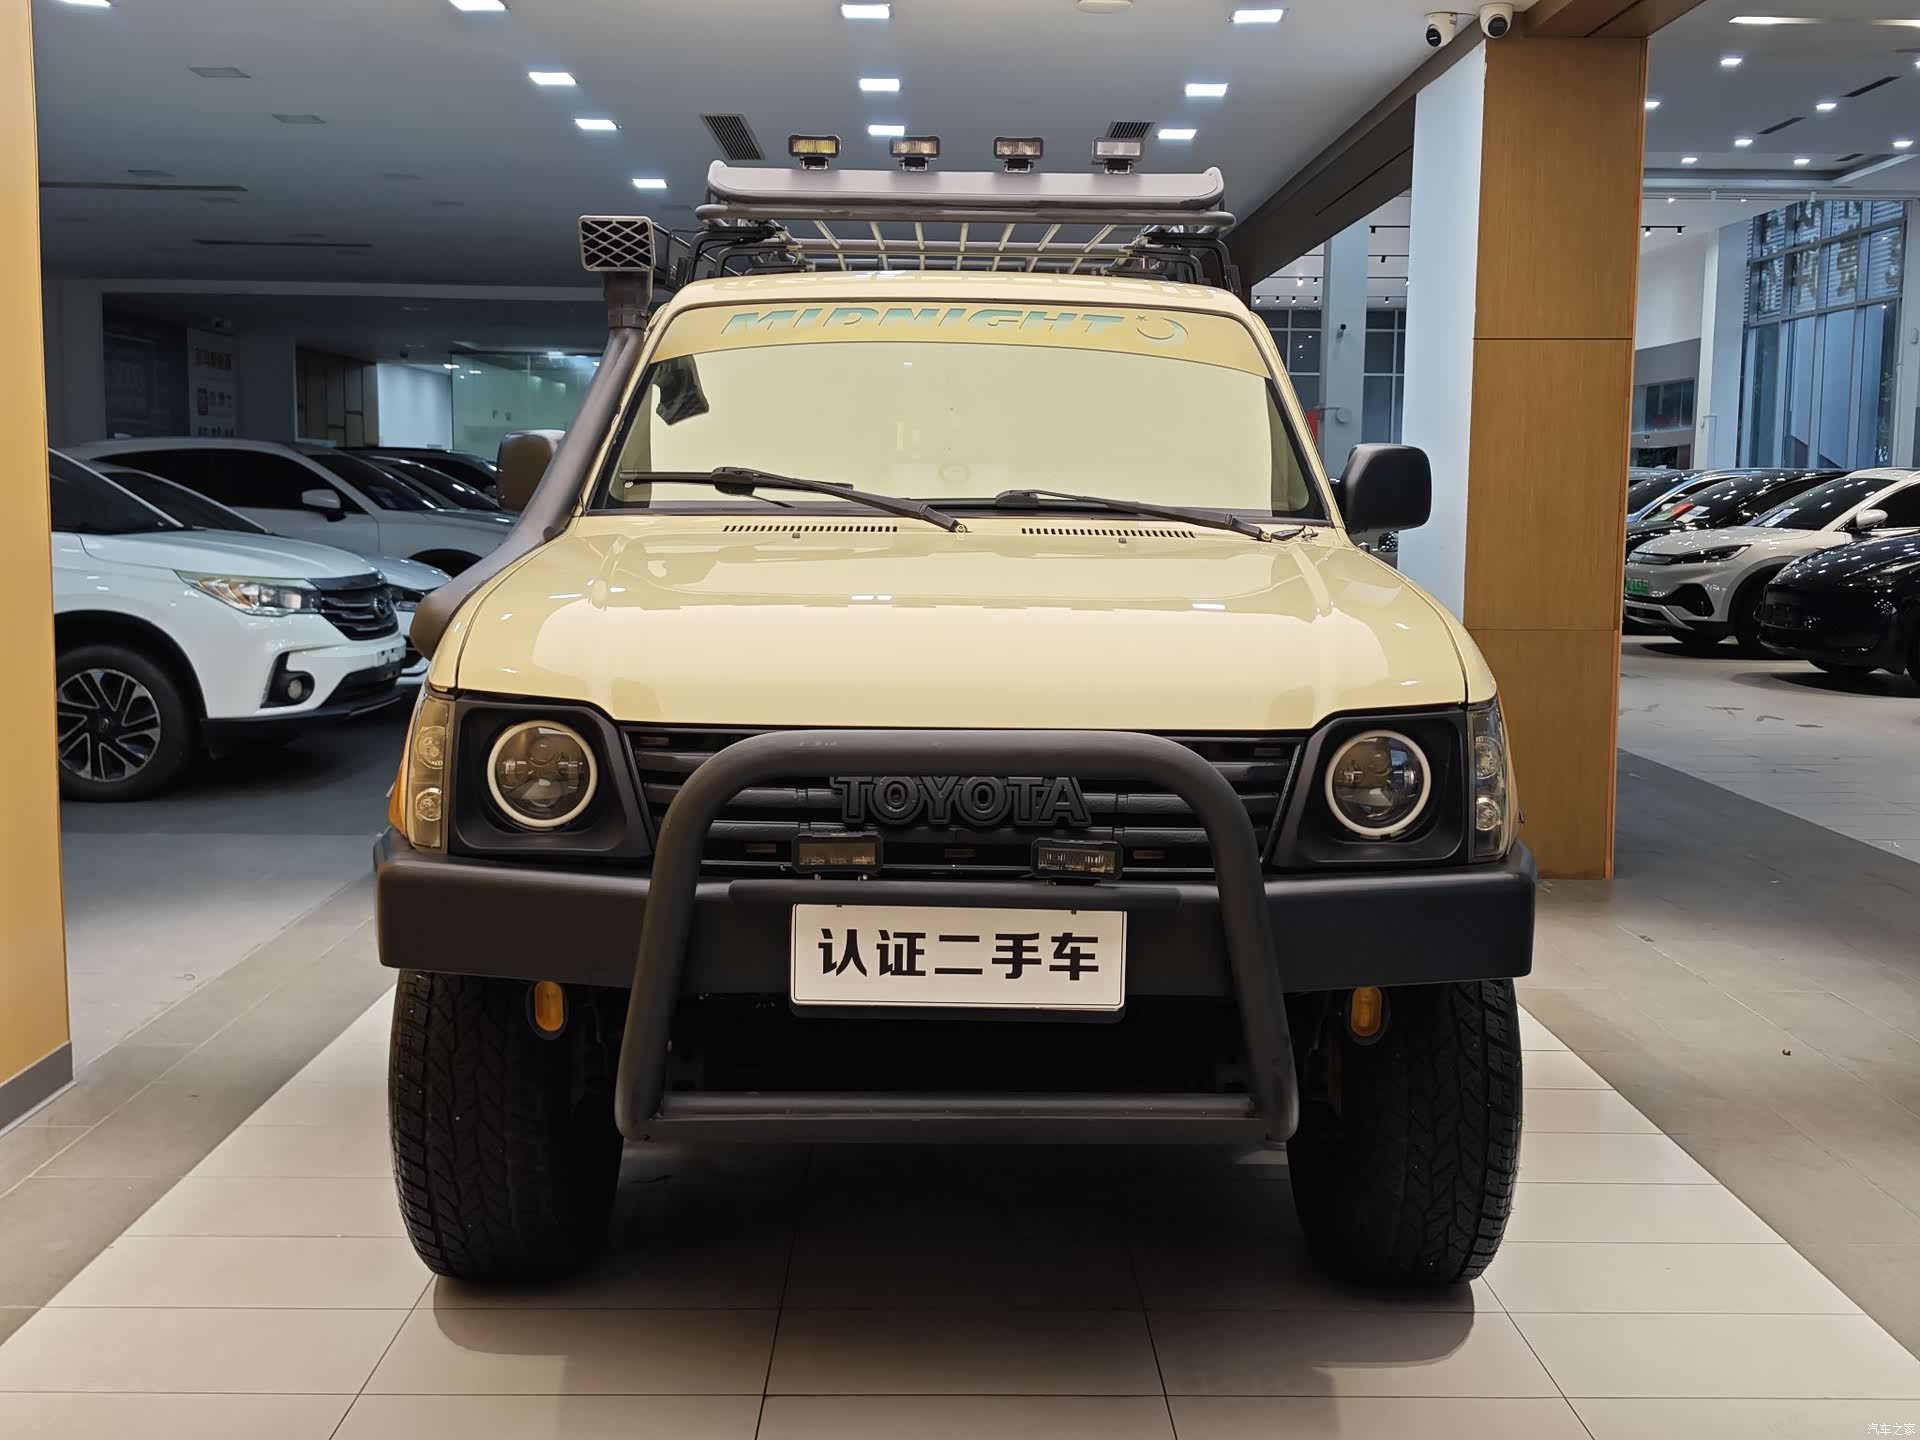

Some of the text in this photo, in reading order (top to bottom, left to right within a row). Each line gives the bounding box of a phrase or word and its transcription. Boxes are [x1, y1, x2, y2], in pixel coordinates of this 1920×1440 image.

[721, 308, 1125, 335] MIDNIGHT
[829, 776, 1091, 827] TOYOTA
[817, 928, 1100, 981] 认证二手车
